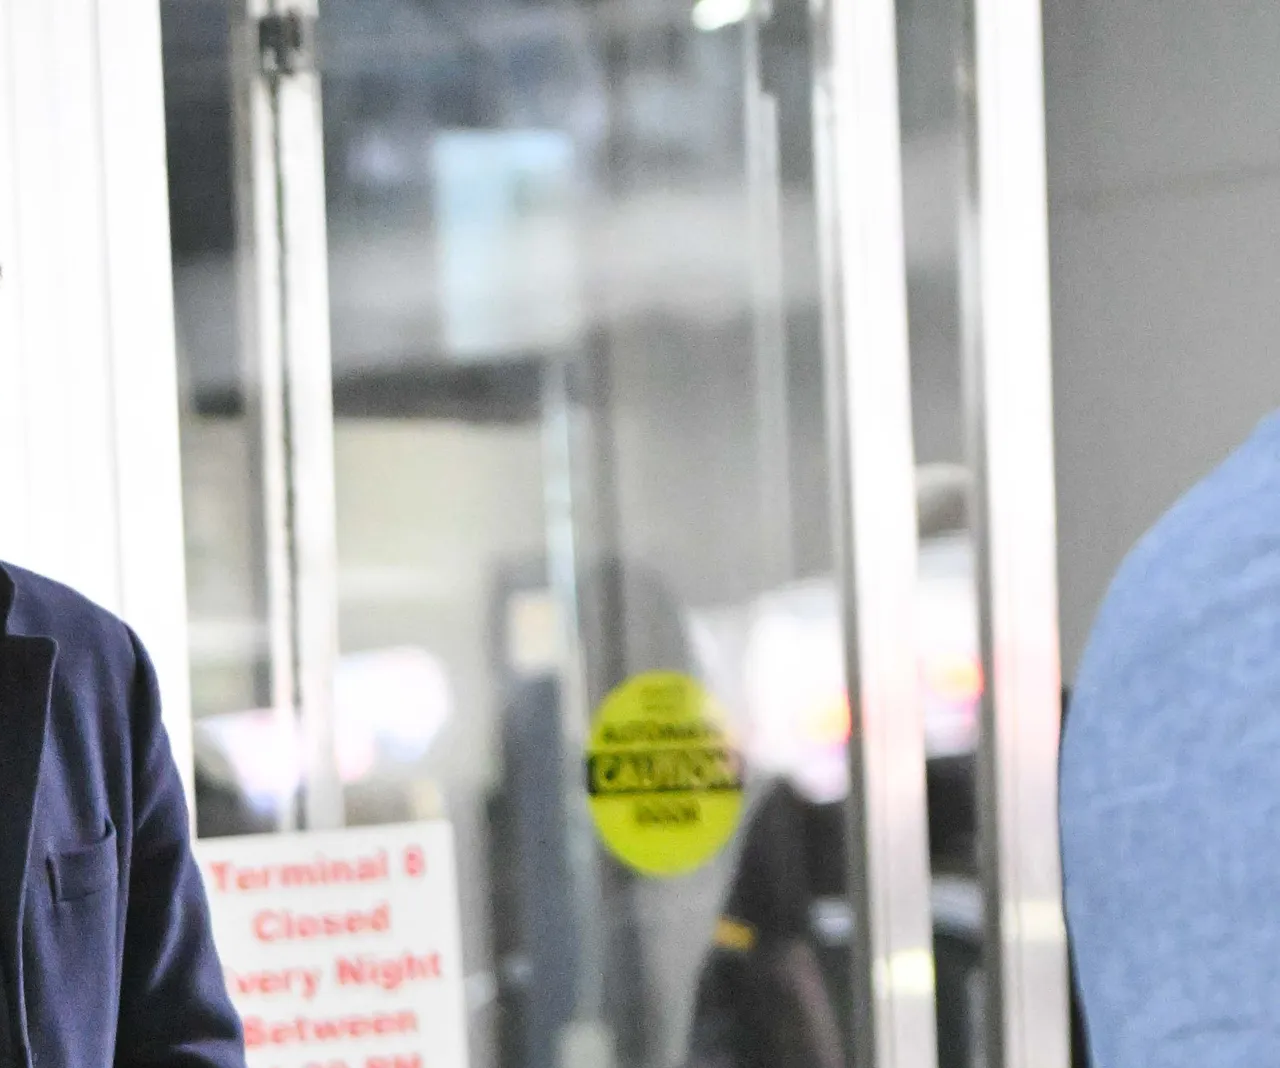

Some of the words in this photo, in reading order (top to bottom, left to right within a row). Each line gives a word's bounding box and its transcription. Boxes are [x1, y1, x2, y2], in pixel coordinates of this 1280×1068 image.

[210, 854, 388, 893] Terminal
[251, 902, 391, 942] Closed
[223, 967, 321, 1001] very
[334, 950, 442, 991] Night
